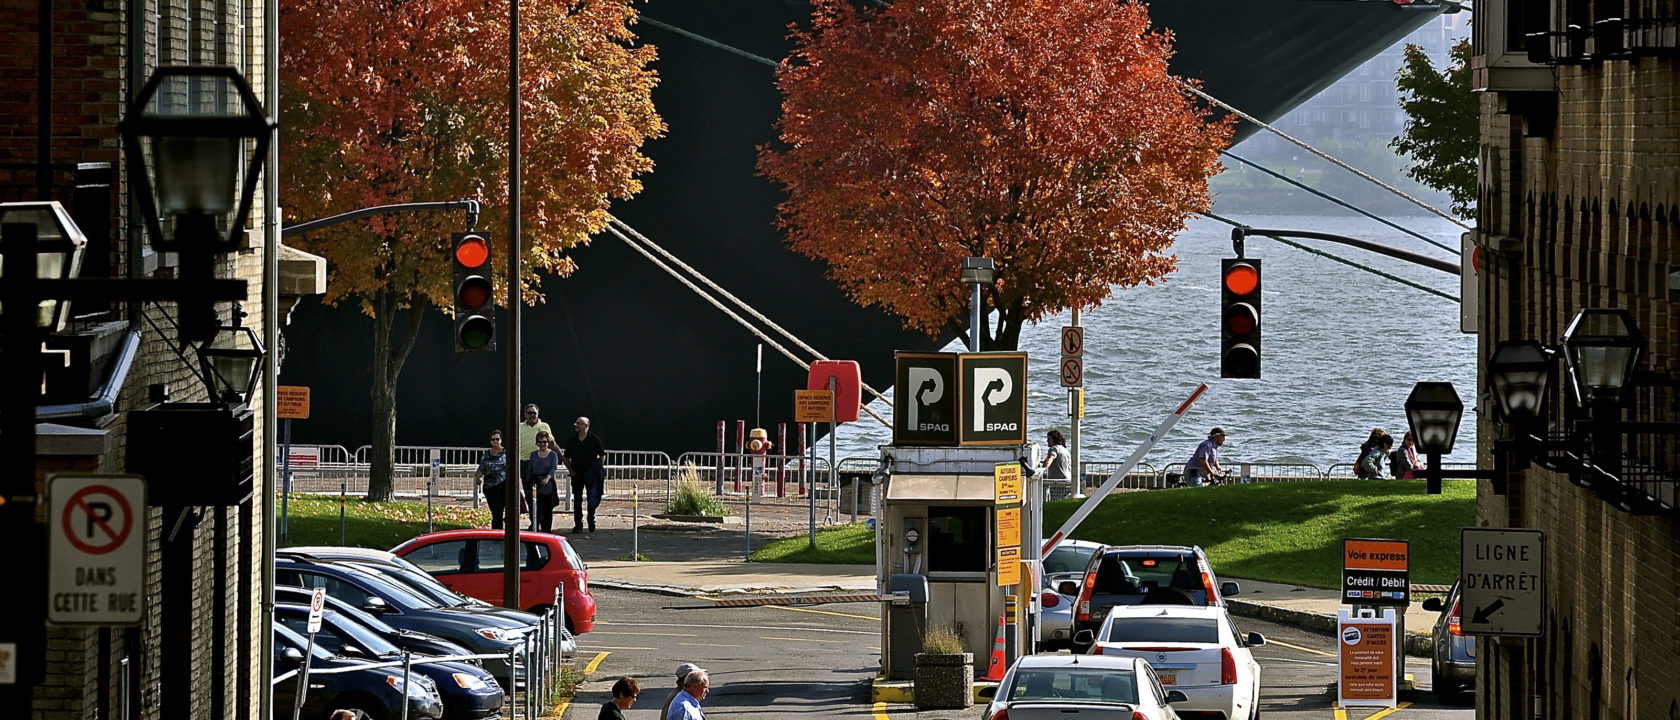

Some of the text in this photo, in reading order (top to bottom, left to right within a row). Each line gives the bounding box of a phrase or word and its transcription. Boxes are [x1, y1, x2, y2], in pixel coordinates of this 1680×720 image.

[920, 423, 949, 431] SPAQ
[986, 423, 1018, 431] SPAQ
[1348, 550, 1406, 562] Voie express
[1476, 544, 1529, 561] LIGNE
[75, 567, 116, 586] DANS
[1347, 576, 1374, 586] Crédit
[1382, 577, 1405, 587] Débit
[1467, 571, 1538, 590] D'ARRÊT
[54, 593, 137, 612] CETTE RUE
